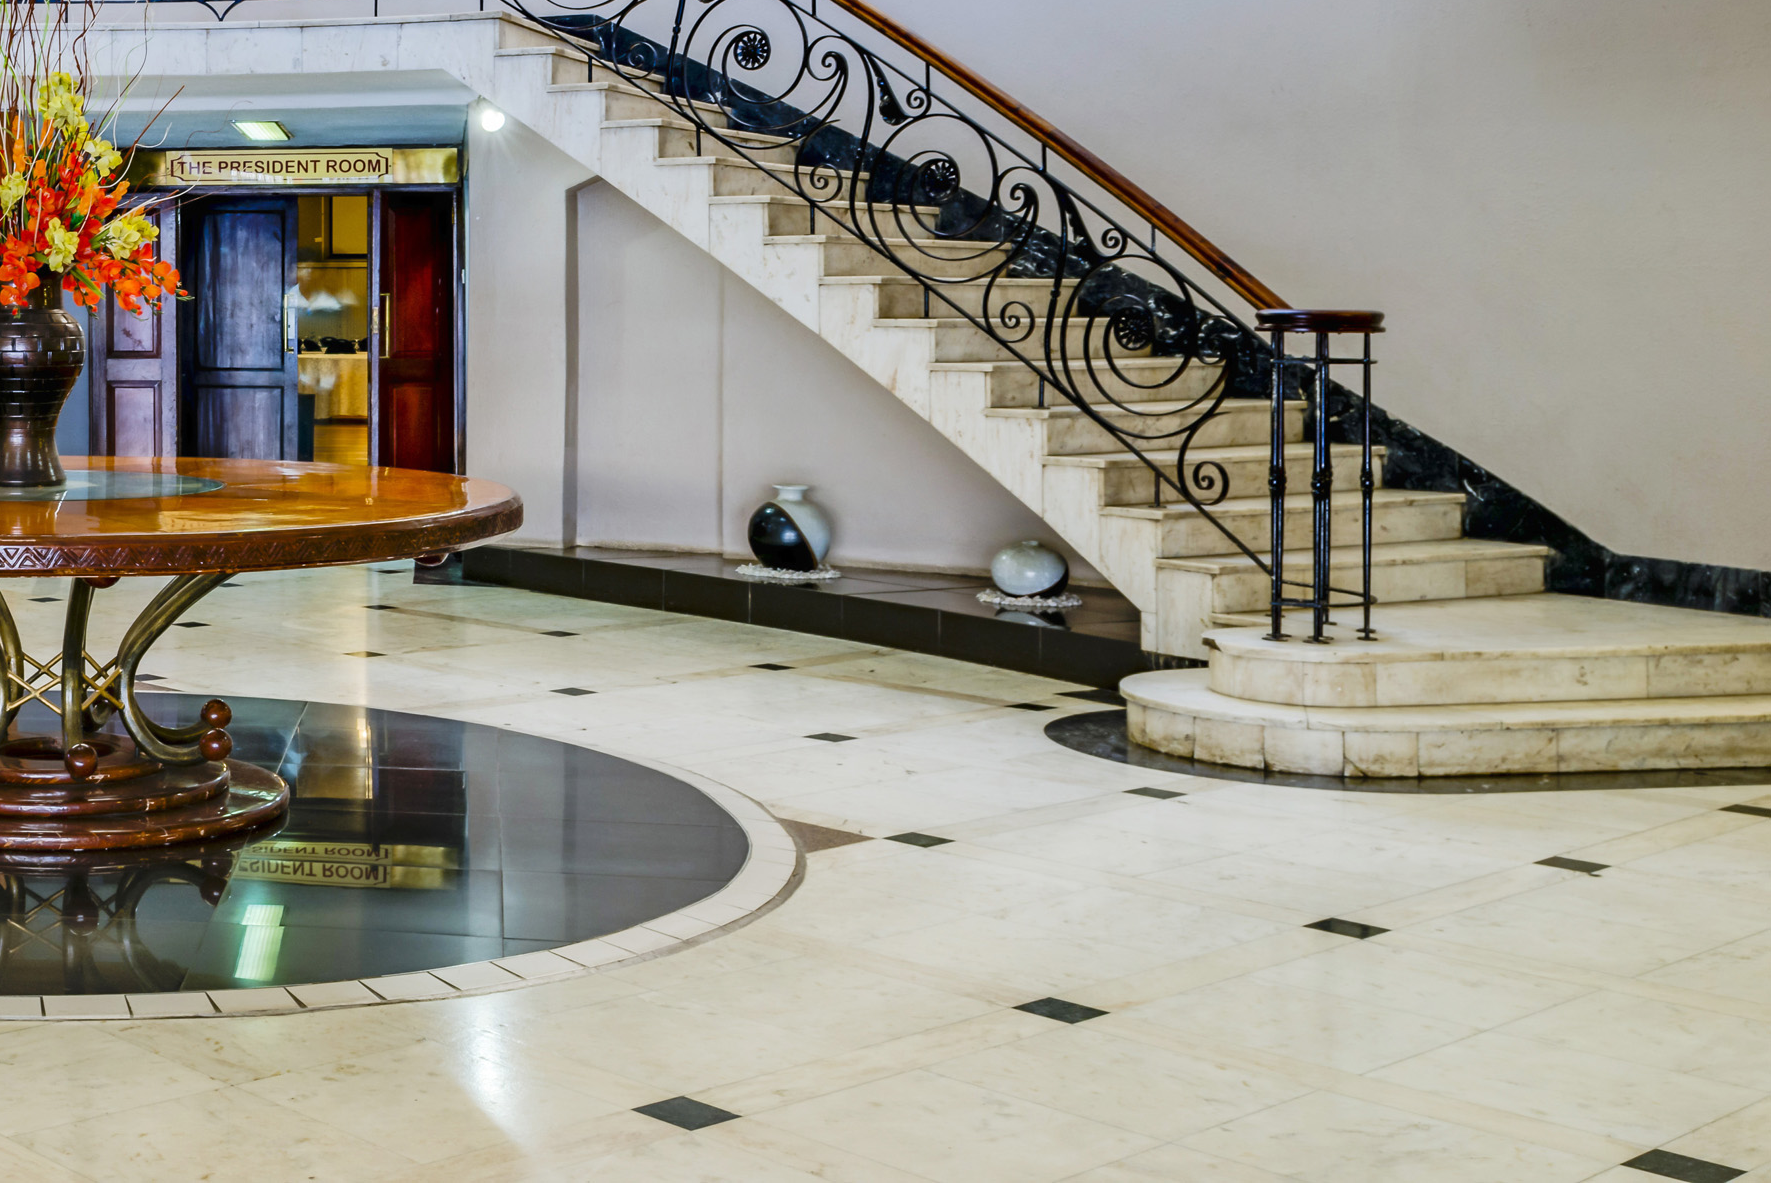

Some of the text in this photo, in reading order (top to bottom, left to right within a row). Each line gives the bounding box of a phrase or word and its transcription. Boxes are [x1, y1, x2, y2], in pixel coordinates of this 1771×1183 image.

[177, 159, 381, 175] THE PRESIDENT ROOM
